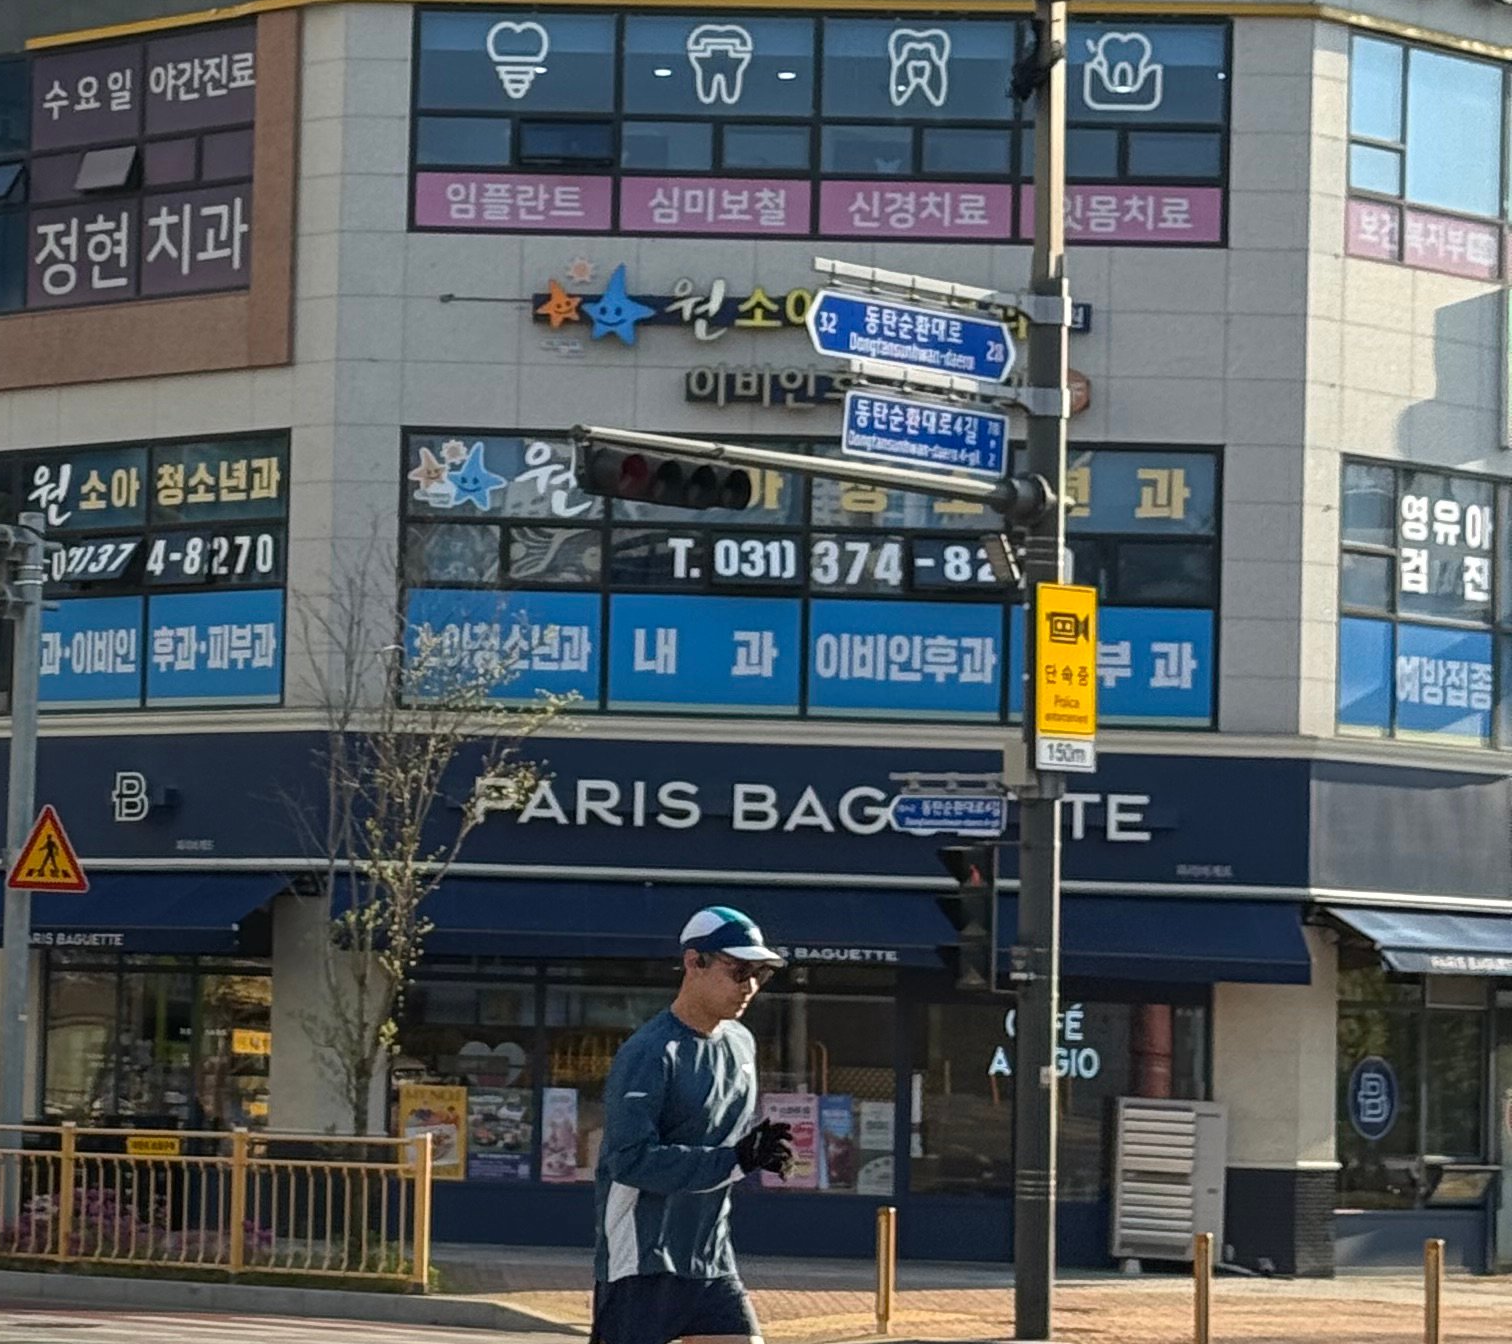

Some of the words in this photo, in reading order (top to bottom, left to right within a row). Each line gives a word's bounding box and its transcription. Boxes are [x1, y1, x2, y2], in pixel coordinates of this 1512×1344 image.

[42, 68, 133, 121] 수요일
[148, 52, 256, 102] 야간진료
[444, 182, 586, 224] 임플란트
[648, 186, 789, 229] 심미보철
[846, 190, 990, 229] 신경치료
[818, 312, 838, 335] 32
[864, 305, 964, 344] 동탄순환대로
[854, 399, 979, 446] 동탄순환대로4길
[78, 467, 141, 511] 소아
[156, 457, 281, 507] 청소년과
[1400, 494, 1493, 550] 영유아
[816, 632, 997, 684] 이비인후과
[473, 776, 702, 829] PARIS
[795, 946, 898, 962] BAGUETTE
